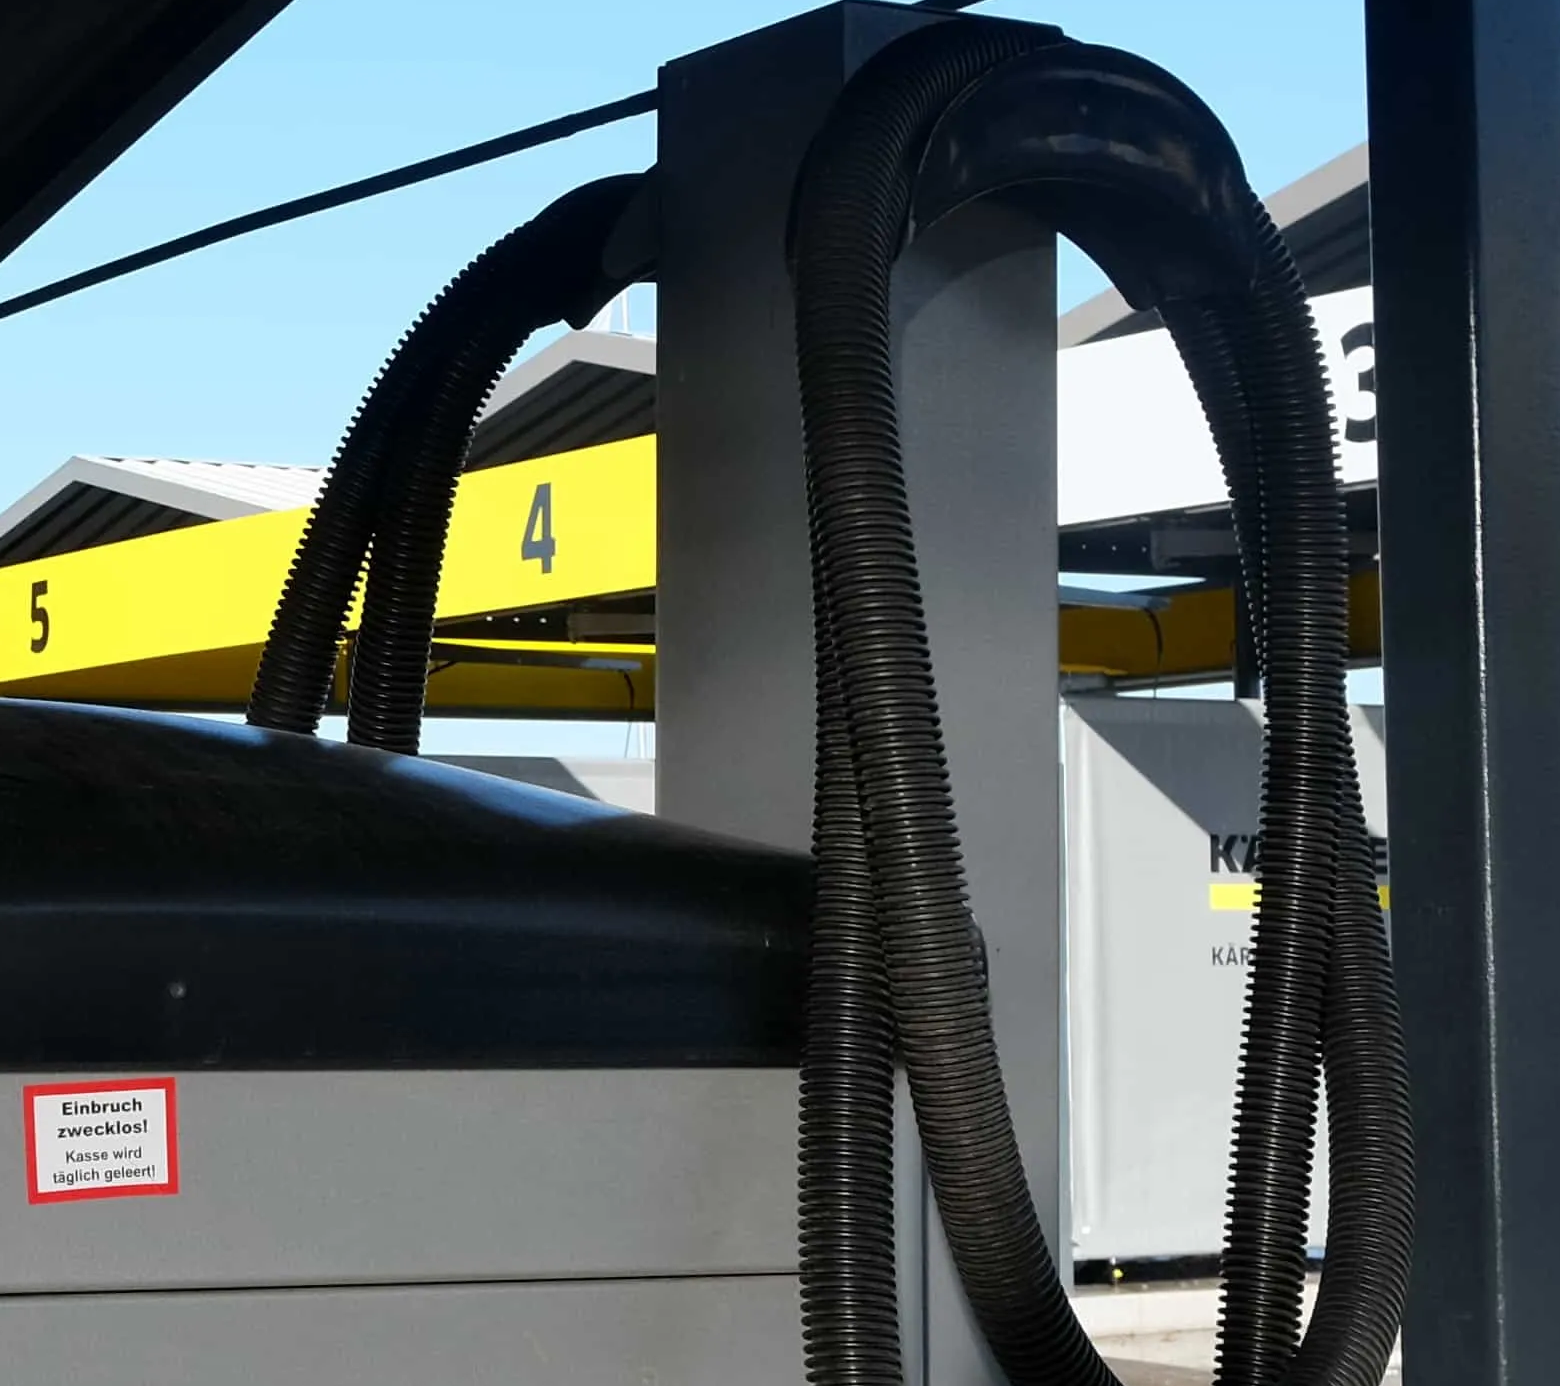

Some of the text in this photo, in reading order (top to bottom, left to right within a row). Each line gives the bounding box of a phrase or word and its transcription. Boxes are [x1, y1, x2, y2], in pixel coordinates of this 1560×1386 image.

[1341, 321, 1378, 443] 3
[520, 482, 556, 574] 4
[30, 580, 49, 653] 5
[61, 1098, 143, 1116] Einbruch
[57, 1119, 148, 1139] zwecklos!
[65, 1146, 143, 1164] Kasse wird
[52, 1165, 156, 1186] täglich geleert!
